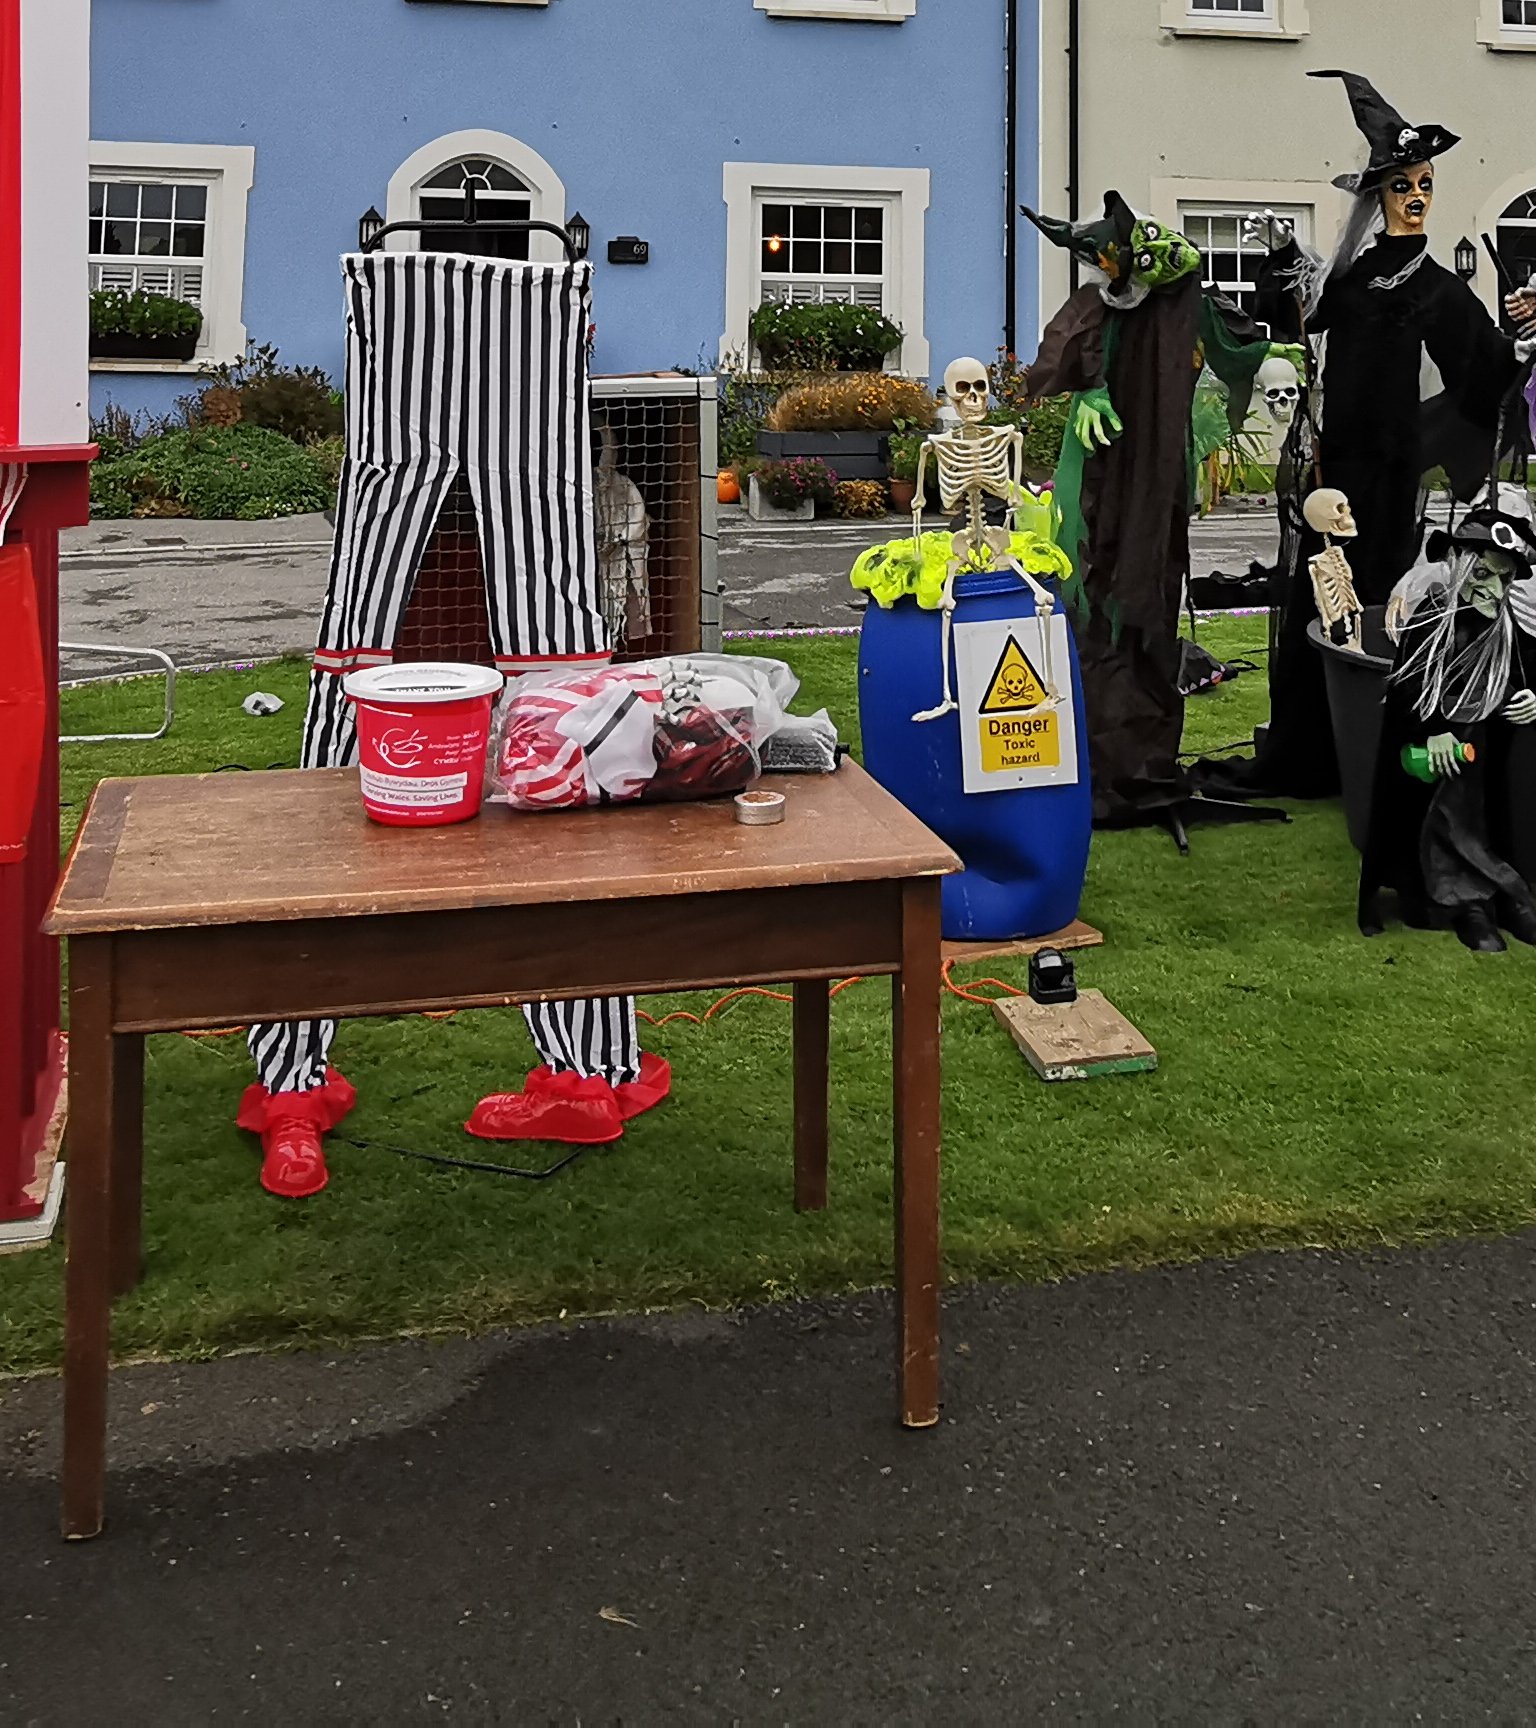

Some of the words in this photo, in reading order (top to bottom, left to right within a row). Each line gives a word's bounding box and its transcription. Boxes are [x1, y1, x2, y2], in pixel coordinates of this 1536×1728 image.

[633, 243, 647, 255] 69
[988, 718, 1049, 737] Danger
[1003, 738, 1035, 751] Toxic
[1001, 752, 1040, 765] hazard
